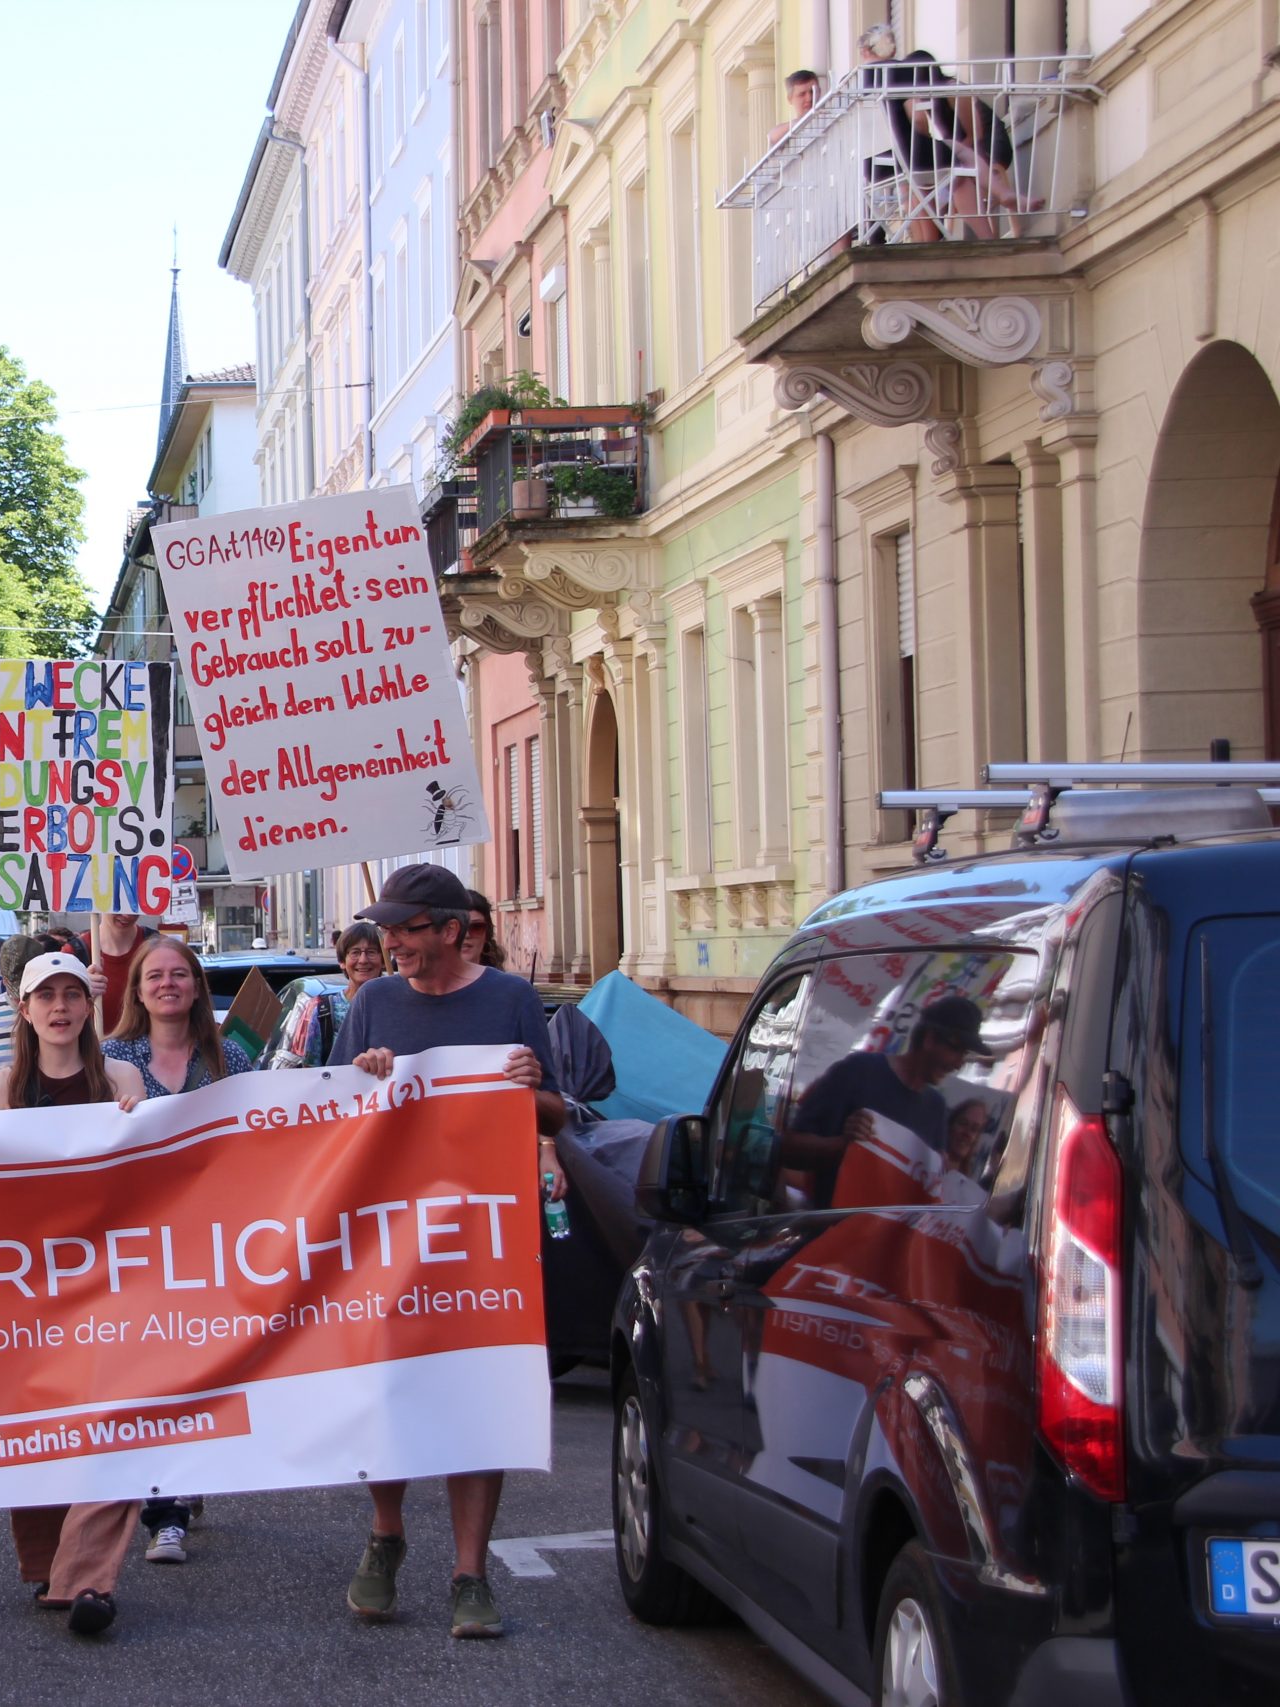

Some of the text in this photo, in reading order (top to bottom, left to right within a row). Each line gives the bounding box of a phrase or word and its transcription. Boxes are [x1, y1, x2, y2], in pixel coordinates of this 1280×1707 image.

[365, 564, 429, 602] sein
[190, 628, 308, 687] Gebrauch
[314, 618, 373, 663] soll
[204, 663, 430, 751] gleich dem Wohle
[221, 719, 451, 801] der Allgemeinheit
[239, 815, 349, 851] dienen.
[245, 1074, 426, 1130] GG Art. 14 (2)
[74, 1315, 131, 1344] der
[141, 1295, 386, 1346] Allgemeinheit
[398, 1285, 523, 1316] dienen
[86, 1409, 214, 1446] Wohnen
[1222, 1584, 1235, 1599] D
